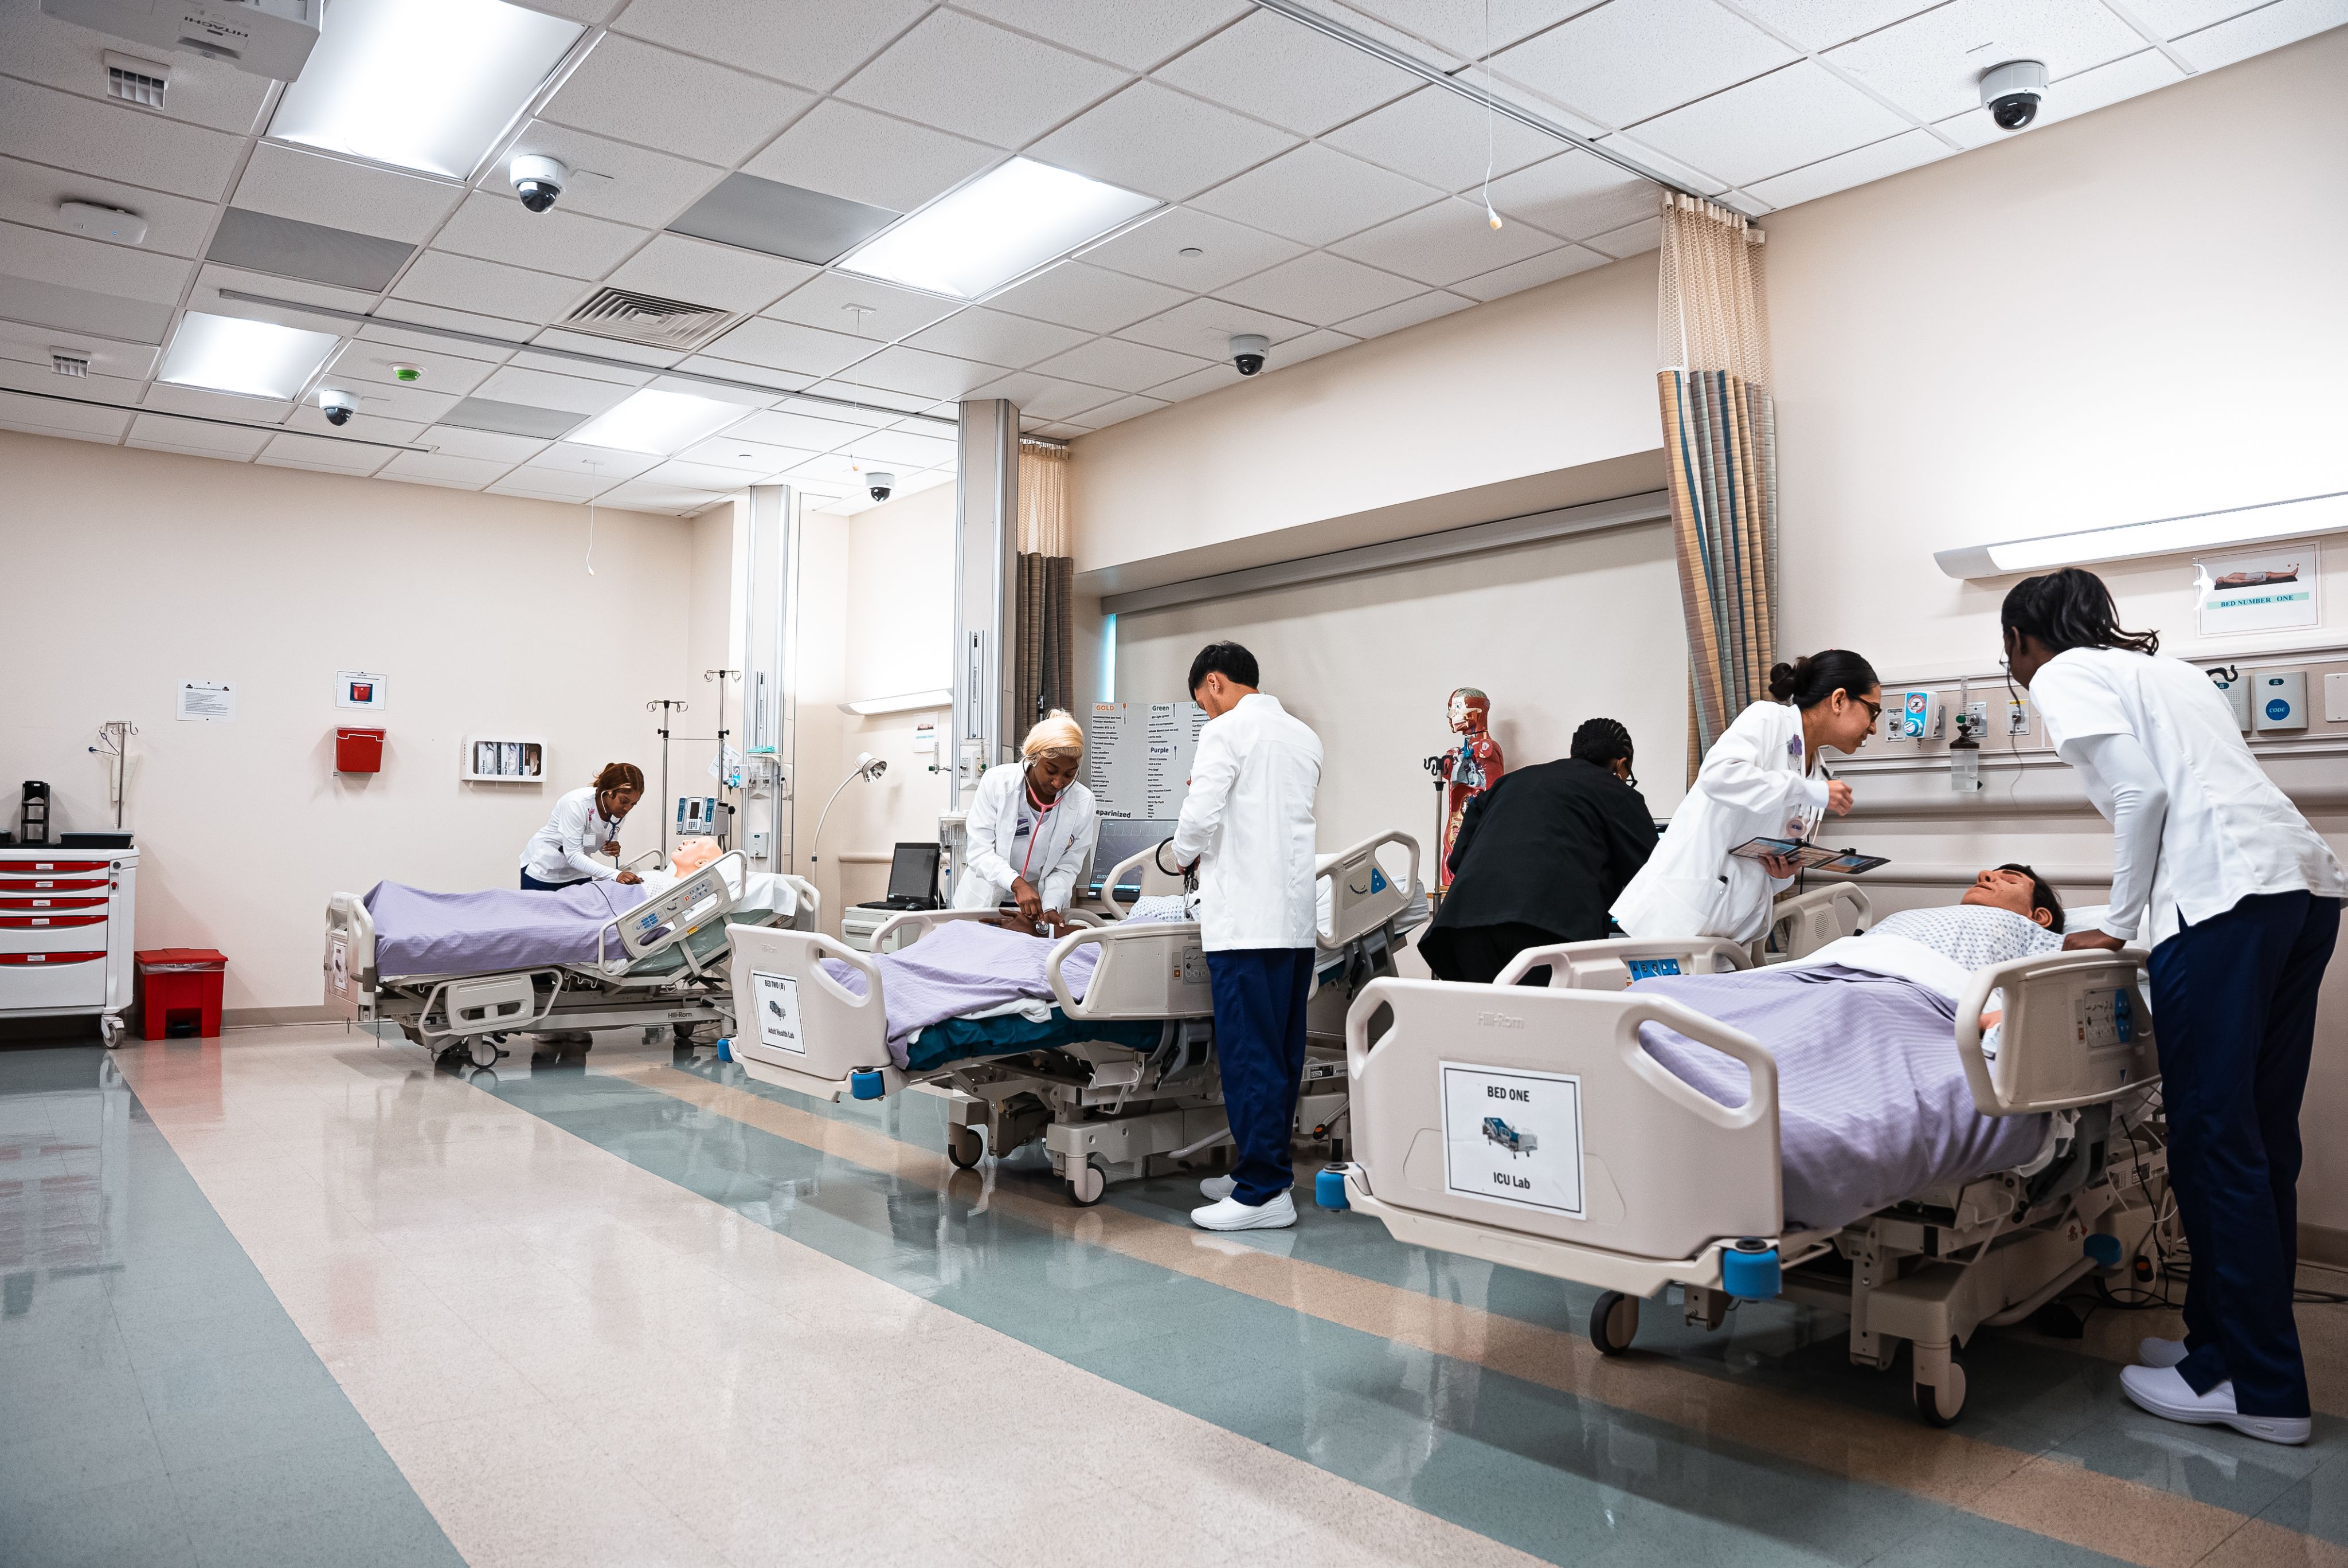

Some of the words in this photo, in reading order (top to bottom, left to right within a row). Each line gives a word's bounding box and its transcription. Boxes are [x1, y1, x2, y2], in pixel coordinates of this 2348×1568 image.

[185, 16, 249, 38] HITACHI
[2238, 598, 2270, 606] NUMBER
[1096, 810, 1131, 818] eparinized
[1477, 1011, 1524, 1028] Hill-Rom
[776, 1029, 788, 1037] Health
[1488, 1086, 1506, 1099] BED
[1509, 1089, 1529, 1102] ONE
[1493, 1172, 1510, 1185] ICU
[1513, 1175, 1530, 1189] Lab
